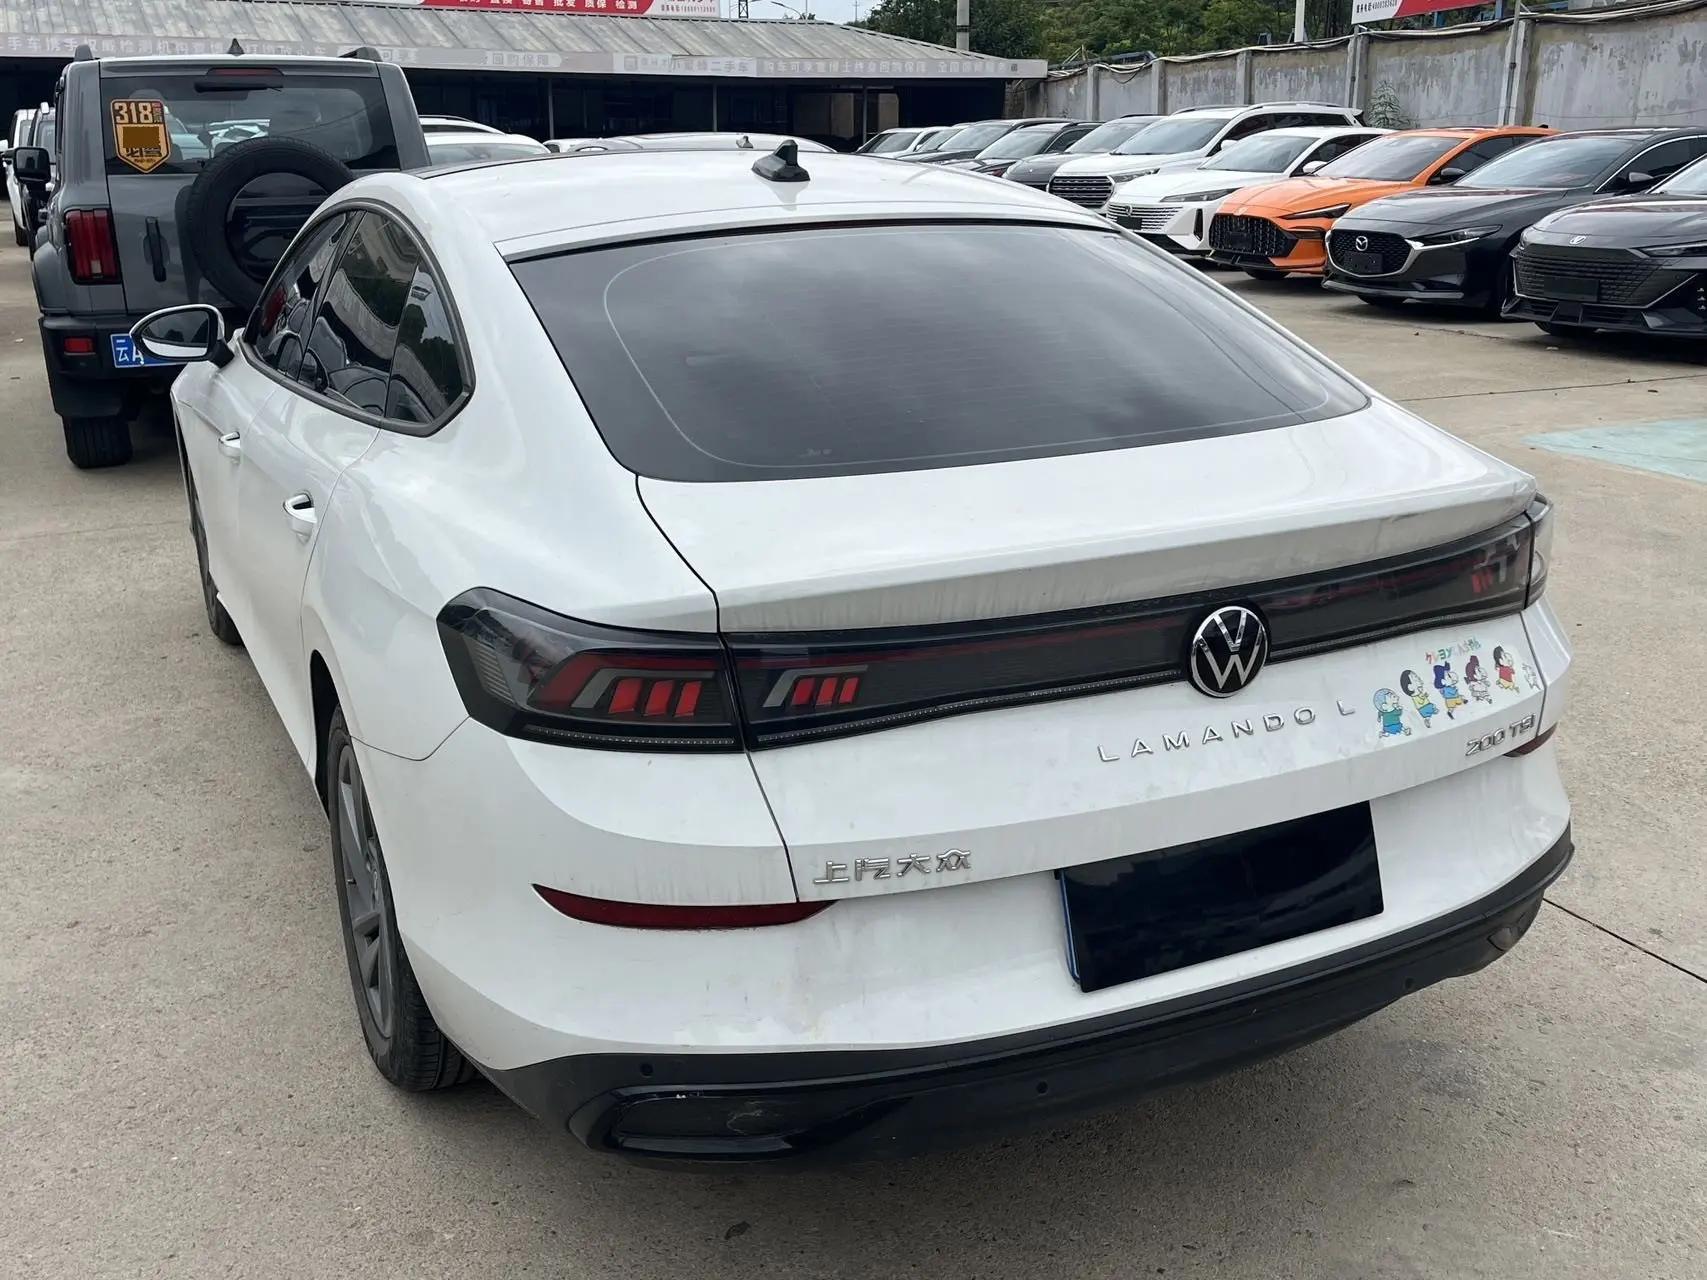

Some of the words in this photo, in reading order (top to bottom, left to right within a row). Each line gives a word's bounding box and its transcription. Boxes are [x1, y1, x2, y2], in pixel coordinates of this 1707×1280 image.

[615, 0, 638, 9] 检测
[113, 102, 153, 124] 318
[1097, 706, 1316, 763] LAMANDO
[1336, 699, 1356, 717] L
[813, 848, 972, 885] 上汽大众
